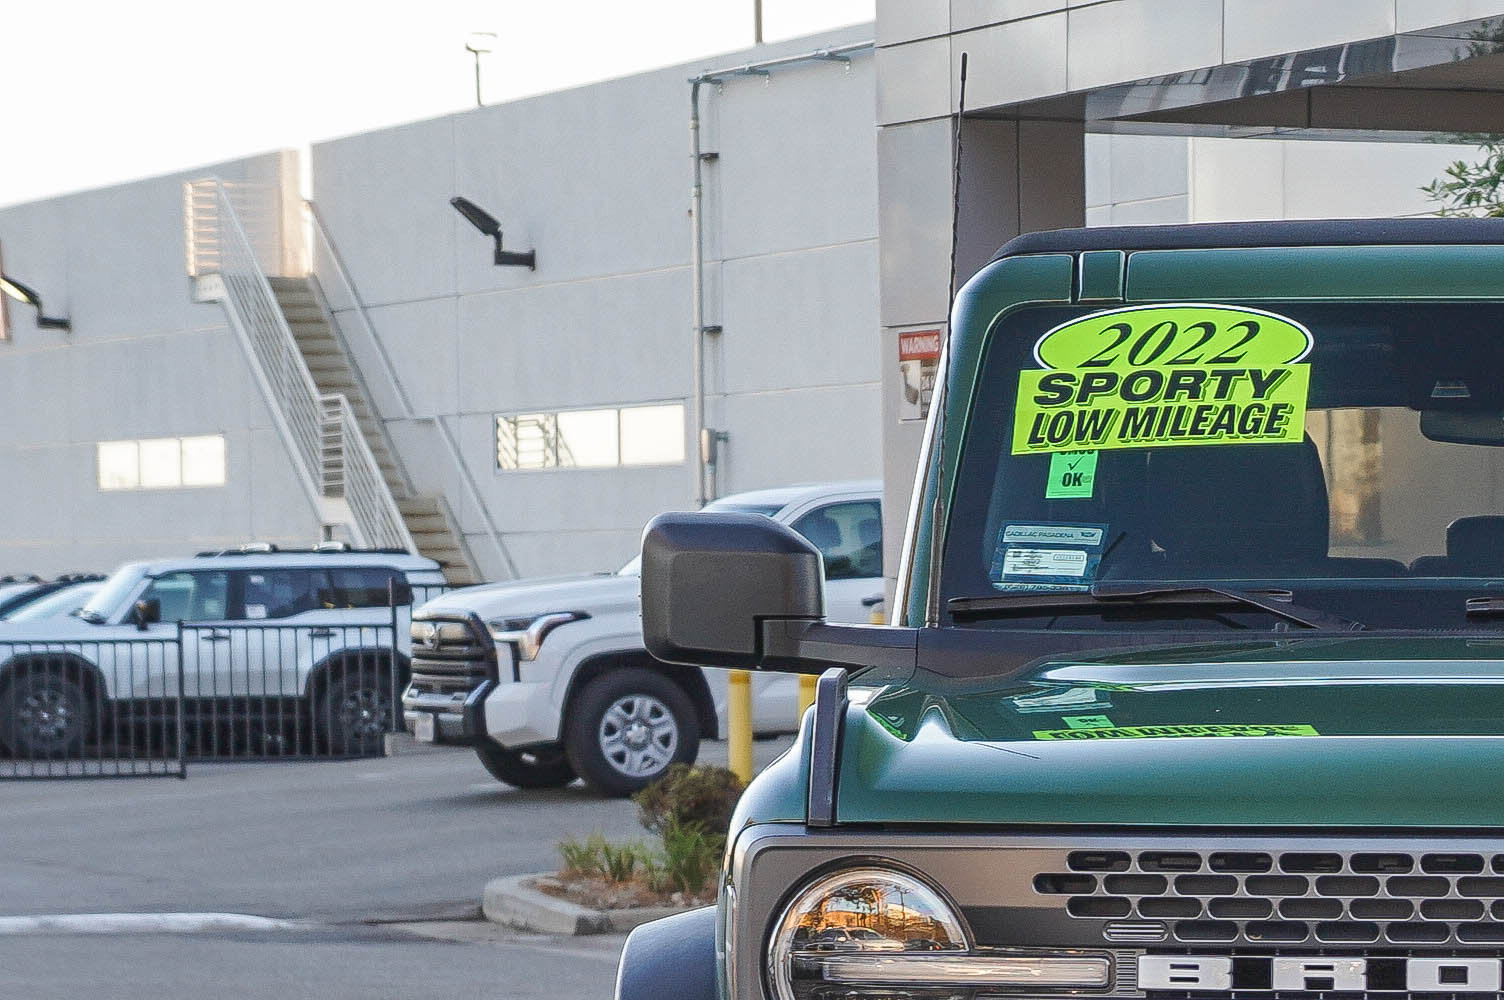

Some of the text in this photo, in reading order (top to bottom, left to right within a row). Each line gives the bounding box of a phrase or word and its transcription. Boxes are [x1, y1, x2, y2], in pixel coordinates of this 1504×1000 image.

[1077, 320, 1261, 367] 2022
[1034, 368, 1292, 407] SPORTY
[1027, 403, 1294, 447] LOW MILEAGE
[1062, 472, 1083, 487] OK
